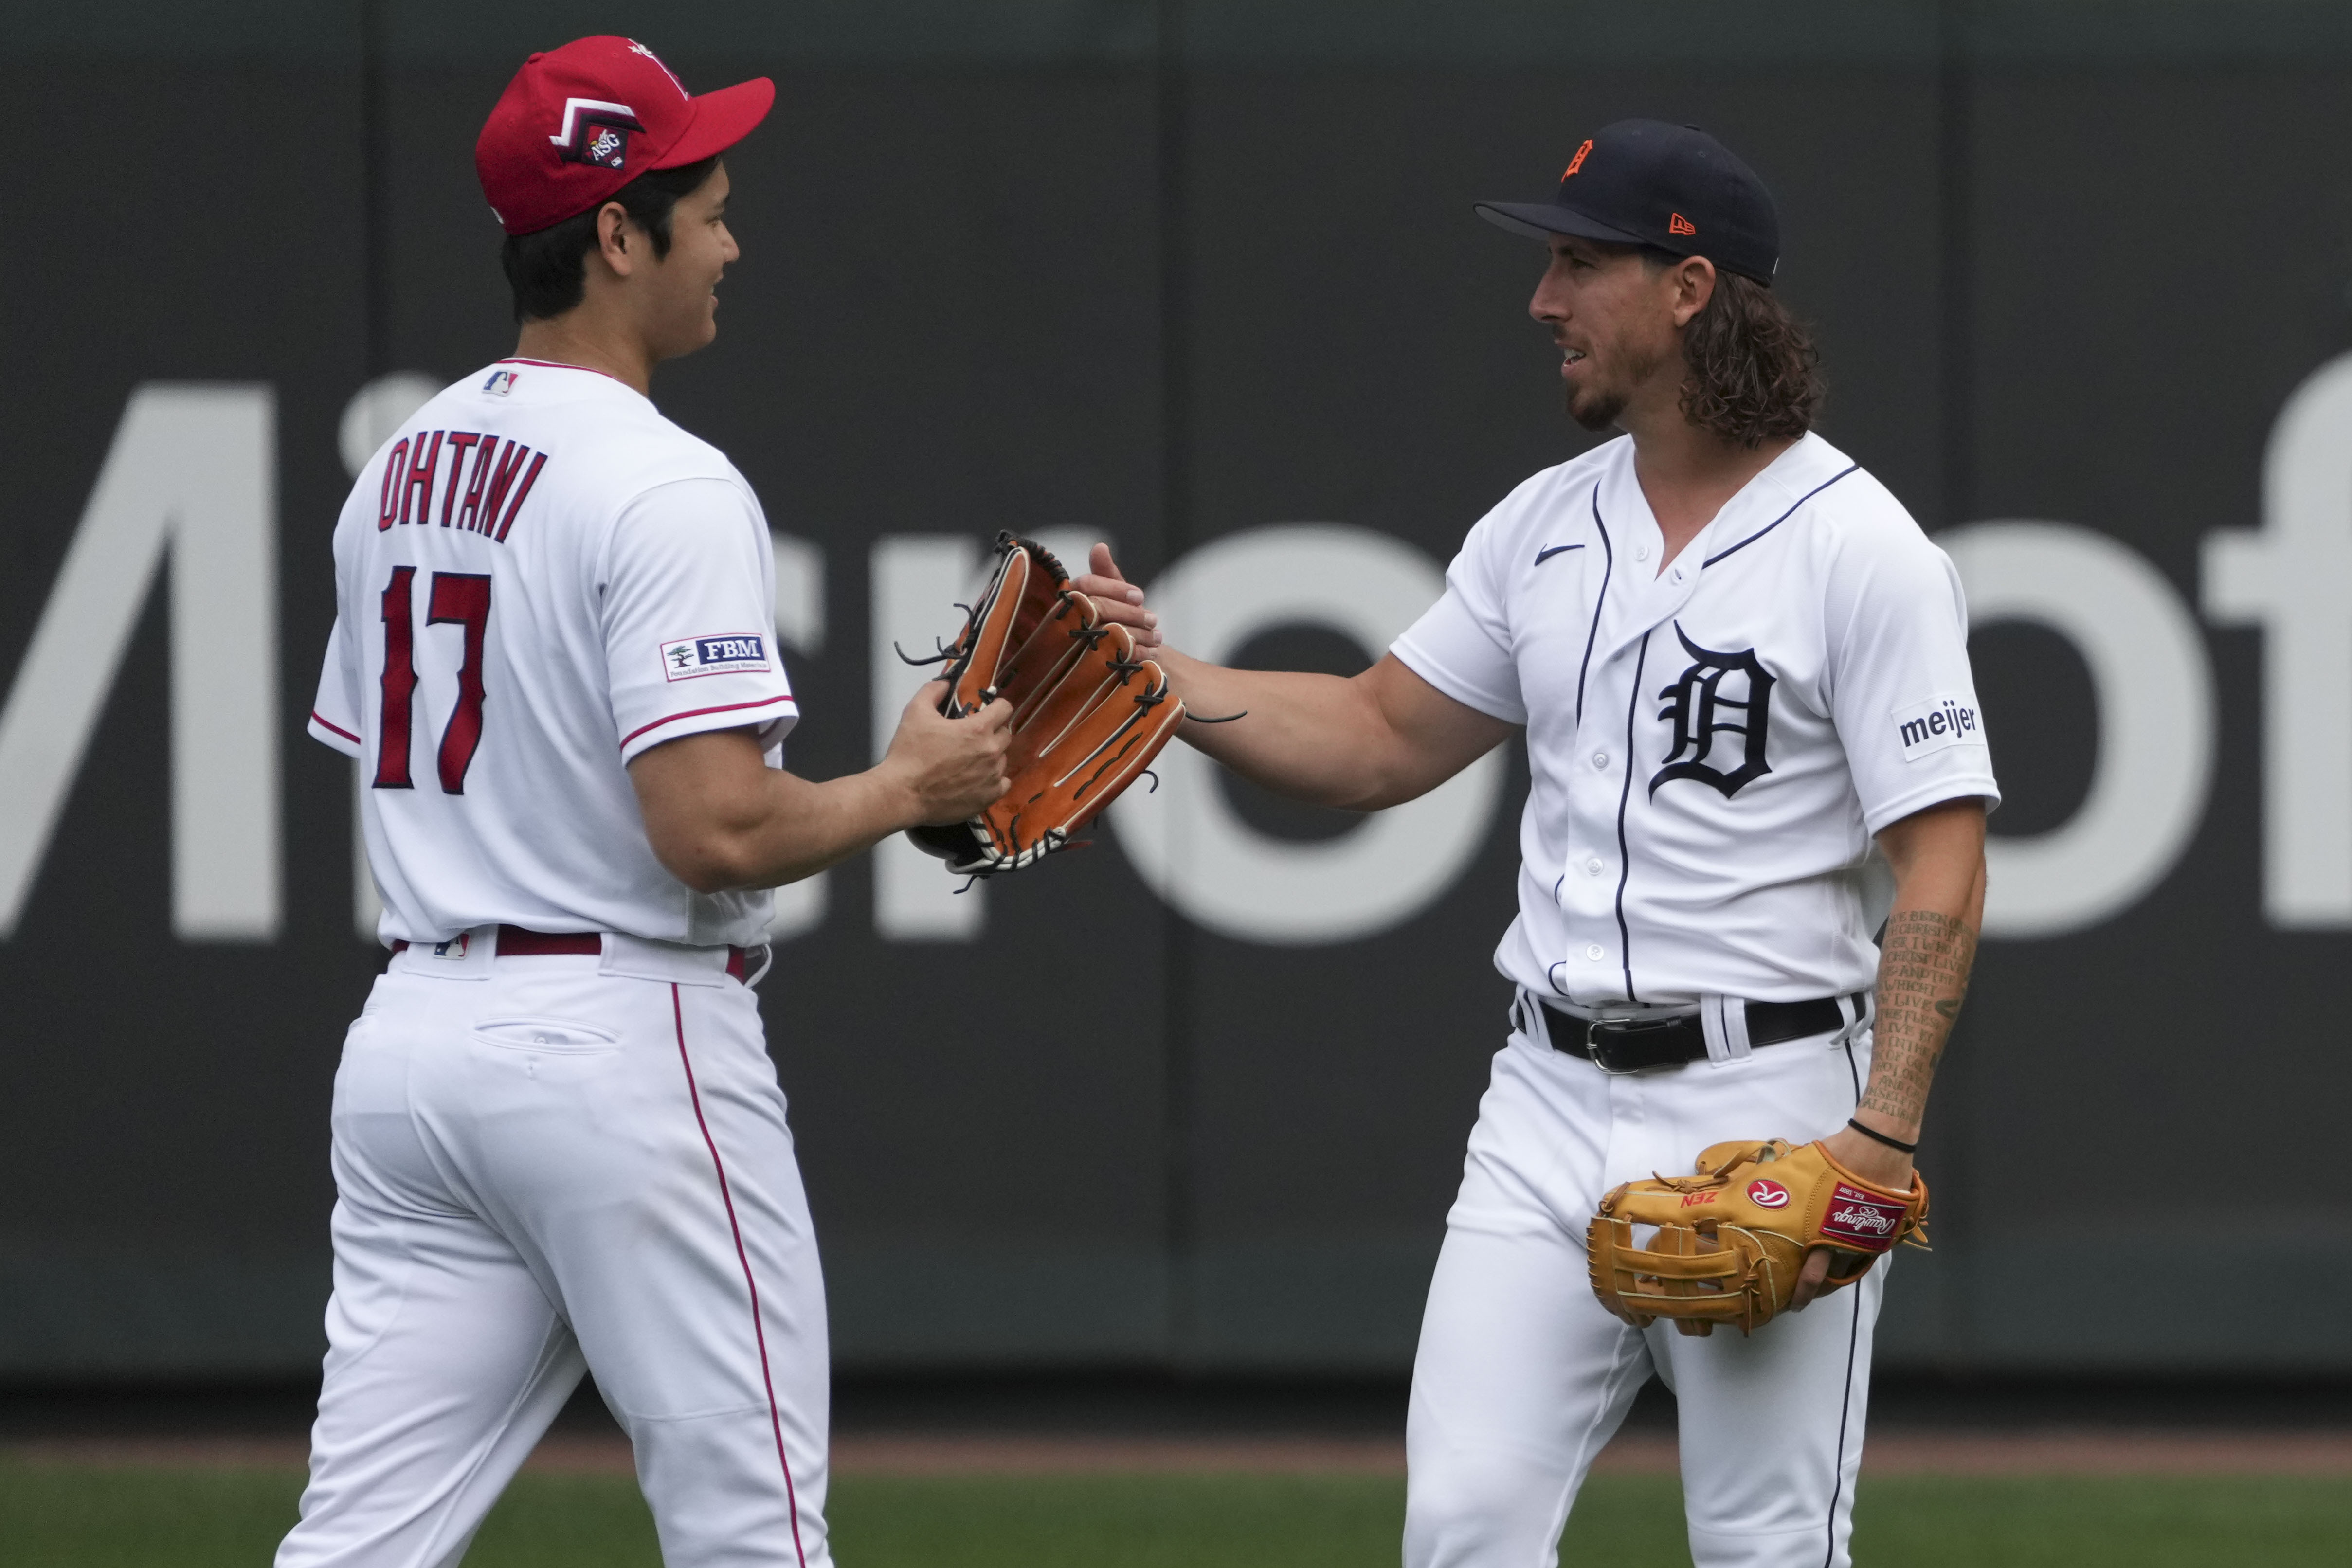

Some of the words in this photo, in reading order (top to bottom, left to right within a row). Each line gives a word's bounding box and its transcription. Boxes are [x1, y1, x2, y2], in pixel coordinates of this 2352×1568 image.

[591, 133, 620, 161] ASG
[378, 430, 548, 544] OHTANI
[704, 639, 760, 660] FBM
[371, 565, 491, 795] 17
[670, 667, 709, 678] Foundation
[1648, 619, 1777, 807] D
[1900, 700, 1976, 747] meijer
[1680, 1192, 1719, 1208] ZEN
[1832, 1206, 1896, 1234] Rawlings
